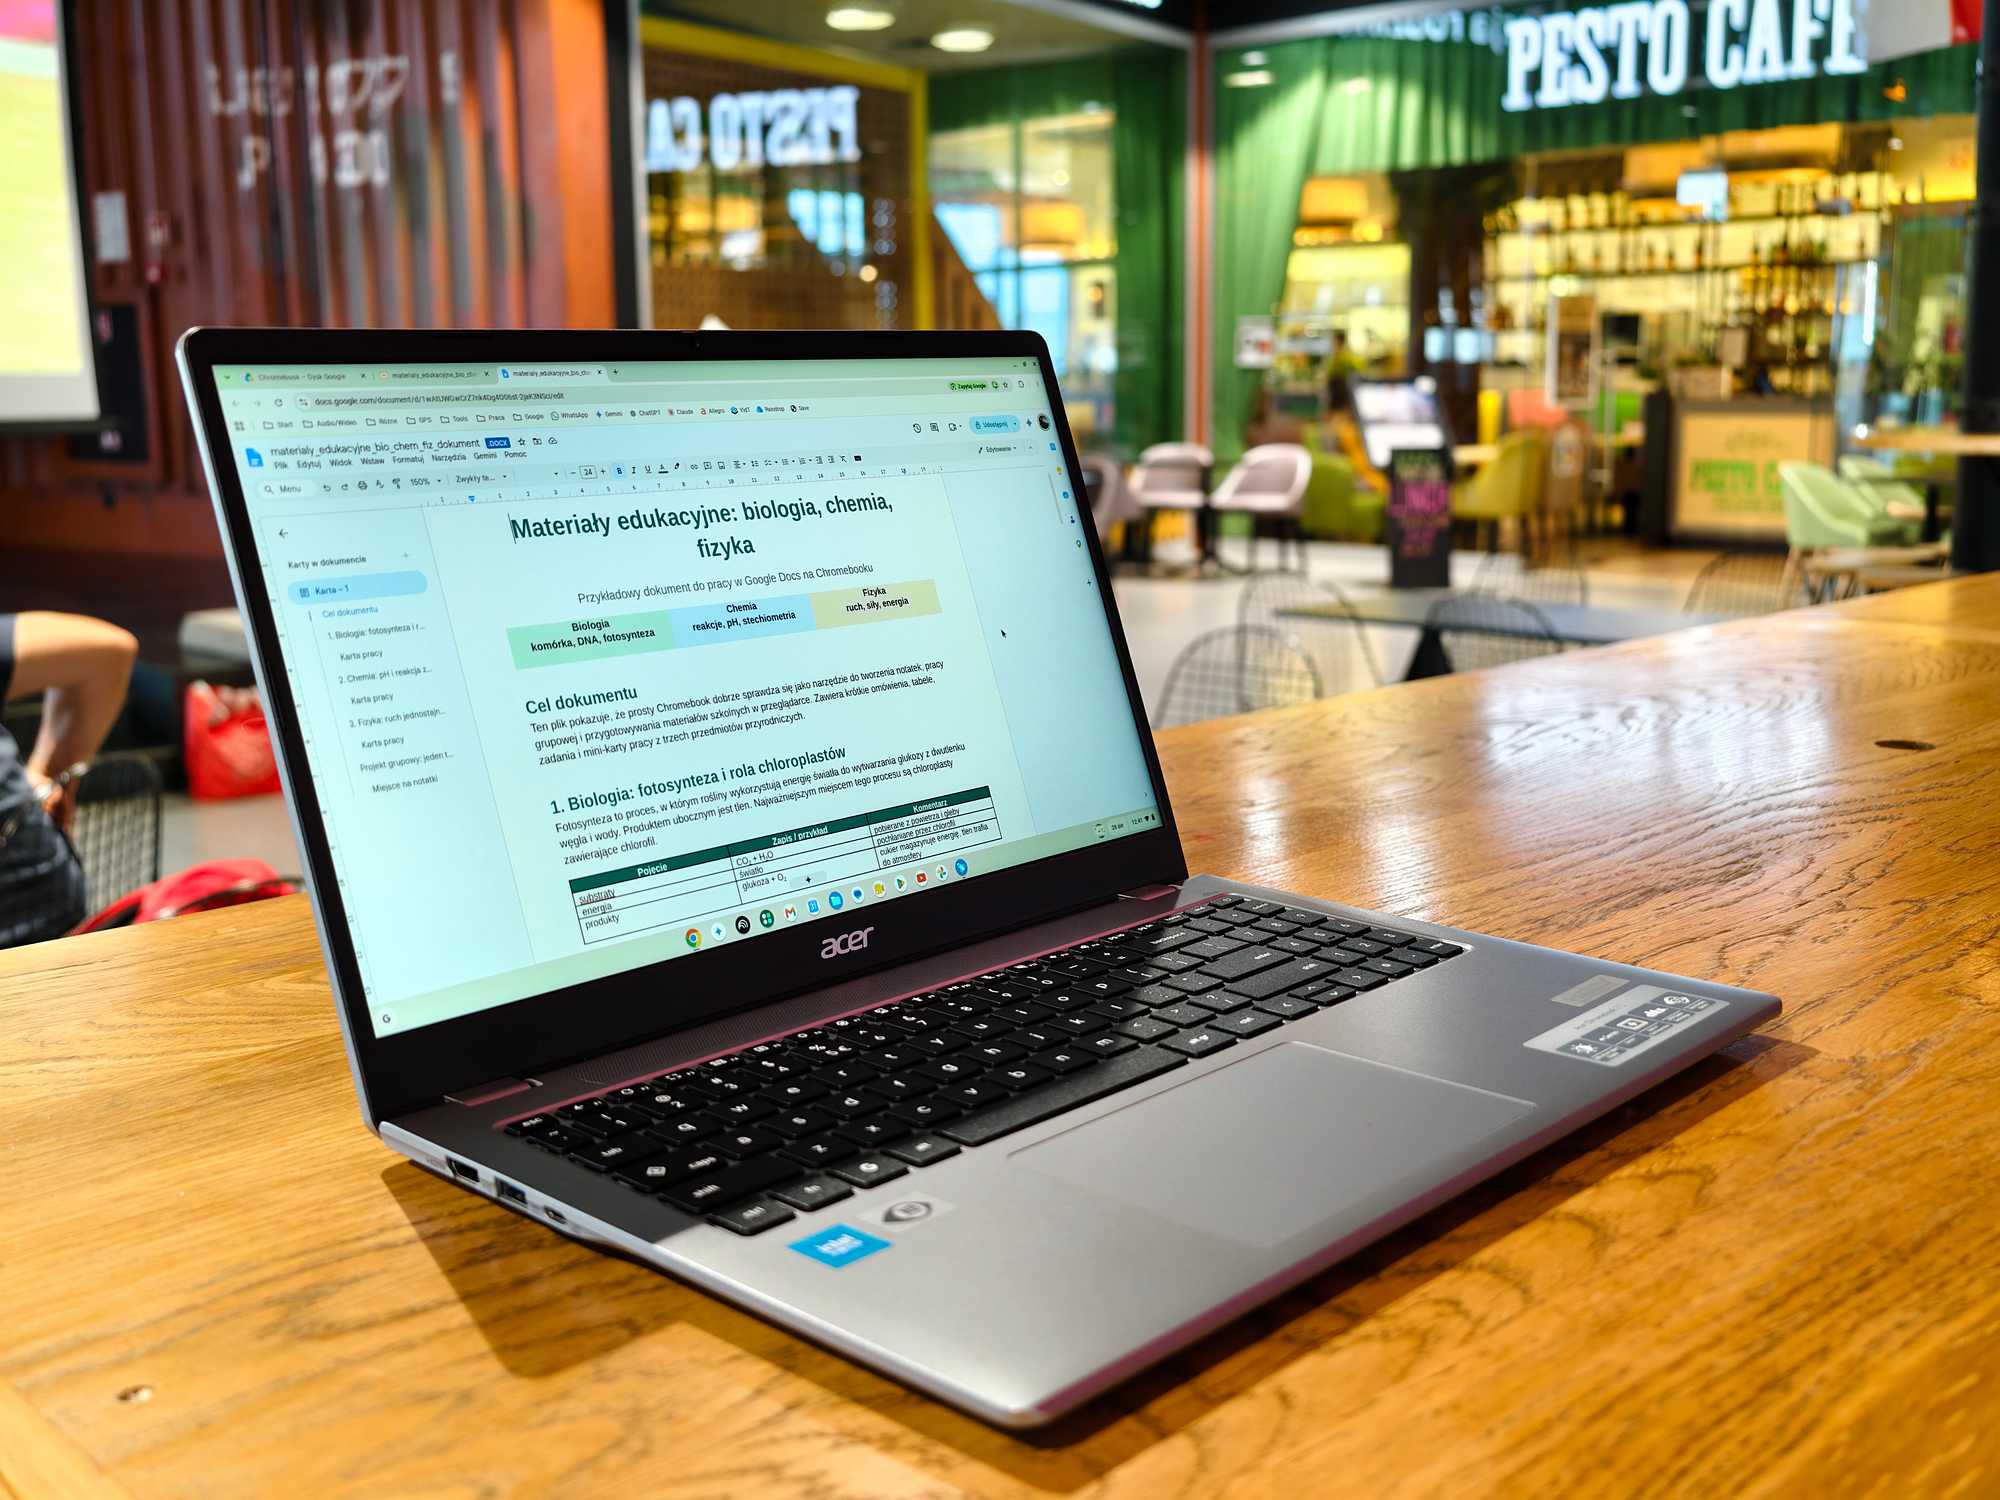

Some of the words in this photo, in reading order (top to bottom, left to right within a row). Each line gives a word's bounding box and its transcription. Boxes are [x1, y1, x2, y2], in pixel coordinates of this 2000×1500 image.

[1502, 0, 1691, 112] PESTO
[561, 412, 588, 420] WhatsApp
[329, 459, 352, 467] Widok
[393, 455, 424, 464] Formatuj
[432, 453, 467, 462] Narzędzia
[474, 452, 497, 460] Gemini
[504, 451, 527, 459] Pomoc
[511, 513, 611, 540] Materiały
[618, 504, 738, 531] edukacyjne:
[742, 498, 823, 522] biologia,
[826, 492, 893, 514] chemia,
[697, 536, 756, 561] fizyka
[288, 560, 309, 570] Karty
[320, 555, 367, 567] dokumencie
[315, 586, 336, 596] Karta
[578, 586, 641, 606] Przykładowy
[644, 580, 691, 598] dokument
[693, 580, 706, 592] do
[707, 577, 732, 593] pracy
[745, 574, 777, 588] Google
[779, 570, 801, 582] Docs
[803, 569, 814, 580] na
[815, 563, 874, 579] Chromebooku
[862, 587, 886, 598] Fizyka
[726, 601, 758, 614] Chemia
[846, 601, 865, 612] ruch,
[866, 598, 881, 611] siły,
[883, 596, 909, 609] energia
[571, 618, 610, 633] Biologia
[692, 620, 726, 633] reakcje,
[727, 617, 741, 629] pH,
[743, 610, 796, 626] stechiometria
[530, 638, 576, 652] komórka,
[577, 635, 602, 647] DNA,
[603, 627, 656, 644] fotosynteza
[362, 649, 383, 660] pracy
[525, 699, 552, 715] Cel
[555, 687, 638, 711] dokumentu
[530, 722, 549, 733] Ten
[551, 717, 567, 732] plik
[569, 712, 613, 729] pokazuje,
[628, 705, 655, 720] prosty
[657, 697, 712, 713] Chromebook
[713, 691, 741, 705] dobrze
[743, 685, 781, 701] sprawdza
[782, 683, 793, 694] się
[795, 680, 811, 693] jako
[812, 675, 849, 690] narzędzie
[850, 673, 860, 683] do
[861, 667, 895, 681] tworzenia
[896, 663, 924, 676] notatek,
[925, 660, 944, 672] pracy
[535, 735, 579, 752] grupowej
[585, 722, 662, 742] przygotowywania
[663, 713, 709, 729] materiałów
[711, 705, 750, 720] szkolnych
[761, 695, 813, 712] przeglądarce.
[814, 691, 844, 703] Zawiera
[845, 685, 870, 698] krótkie
[871, 680, 911, 694] omówienia,
[911, 675, 936, 687] tabele,
[539, 752, 576, 766] zadania
[584, 743, 627, 758] mini-karty
[629, 739, 654, 752] pracy
[663, 731, 690, 744] trzech
[691, 722, 744, 740] przedmiotów
[745, 711, 806, 731] przyrodniczych.
[550, 799, 565, 814] 1.
[568, 787, 635, 812] Biologia:
[638, 771, 720, 798] fotosynteza
[730, 763, 755, 779] rola
[758, 746, 846, 775] chloroplastów
[555, 815, 613, 834] Fotosynteza
[614, 812, 624, 823] to
[626, 807, 659, 822] proces,
[669, 798, 699, 812] którym
[701, 792, 728, 807] rośliny
[730, 781, 782, 799] wykorzystują
[782, 774, 811, 788] energię
[813, 767, 839, 781] światła
[840, 765, 850, 775] do
[851, 758, 896, 773] wytwarzania
[898, 752, 925, 766] glukozy
[931, 743, 966, 757] dwutlenku
[559, 834, 588, 849] węgla
[594, 828, 622, 842] wody.
[623, 818, 671, 835] Produktem
[673, 809, 717, 826] ubocznym
[717, 805, 733, 818] jest
[734, 801, 753, 813] tlen.
[754, 789, 817, 809] Najważniejszym
[818, 780, 854, 795] miejscem
[855, 776, 871, 789] tego
[873, 770, 901, 785] procesu
[913, 758, 954, 775] chloroplasty
[772, 834, 792, 847] Zapis
[799, 826, 829, 841] przykład
[913, 799, 948, 813] Komentarz
[874, 820, 905, 834] pobierane
[911, 812, 940, 826] powietrza
[944, 808, 960, 819] gleby
[915, 827, 932, 839] przez
[932, 820, 956, 833] chlorofil
[564, 846, 619, 866] zawierające
[620, 836, 659, 854] chlorofil.
[880, 844, 899, 857] cukier
[900, 836, 936, 852] magazynuje
[974, 823, 989, 834] trafia
[892, 851, 922, 864] atmosfery
[739, 866, 763, 879] światło
[742, 876, 770, 892] glukoza
[579, 888, 615, 904] substraty
[582, 902, 613, 916] energia
[585, 914, 620, 930] produkty
[821, 926, 875, 959] acer
[1068, 1017, 1086, 1025] k
